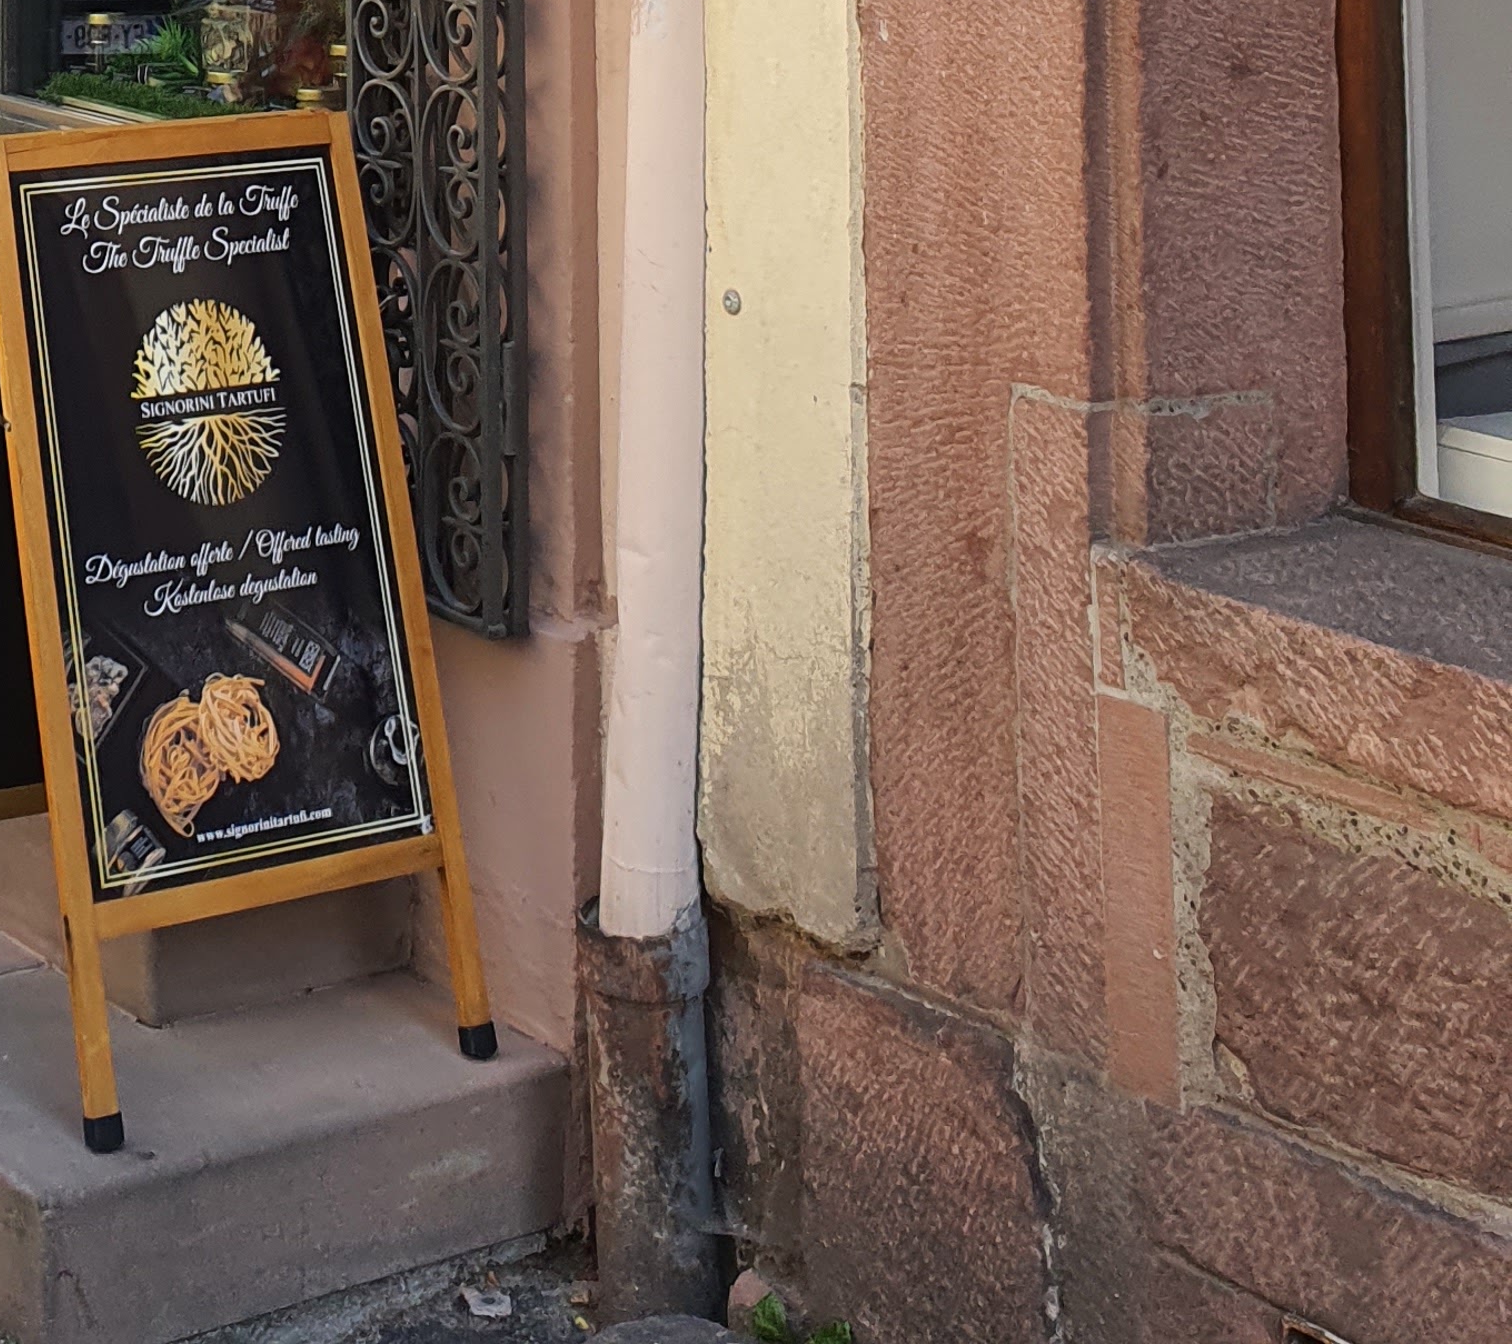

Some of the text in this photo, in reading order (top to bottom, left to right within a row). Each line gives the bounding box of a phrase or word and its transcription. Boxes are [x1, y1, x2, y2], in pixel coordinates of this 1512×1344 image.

[60, 184, 299, 239] Le Spécialiste de la Truffe
[82, 226, 291, 274] The Truffle Specialist
[140, 387, 277, 419] SIGNORINI TARTUFI
[84, 550, 186, 589] Dégustation
[190, 540, 235, 577] offerte
[255, 526, 312, 565] Offered
[315, 522, 361, 551] tasting
[143, 566, 318, 618] Kostenlose degustation
[195, 807, 333, 844] www.signorinitartufi.com
